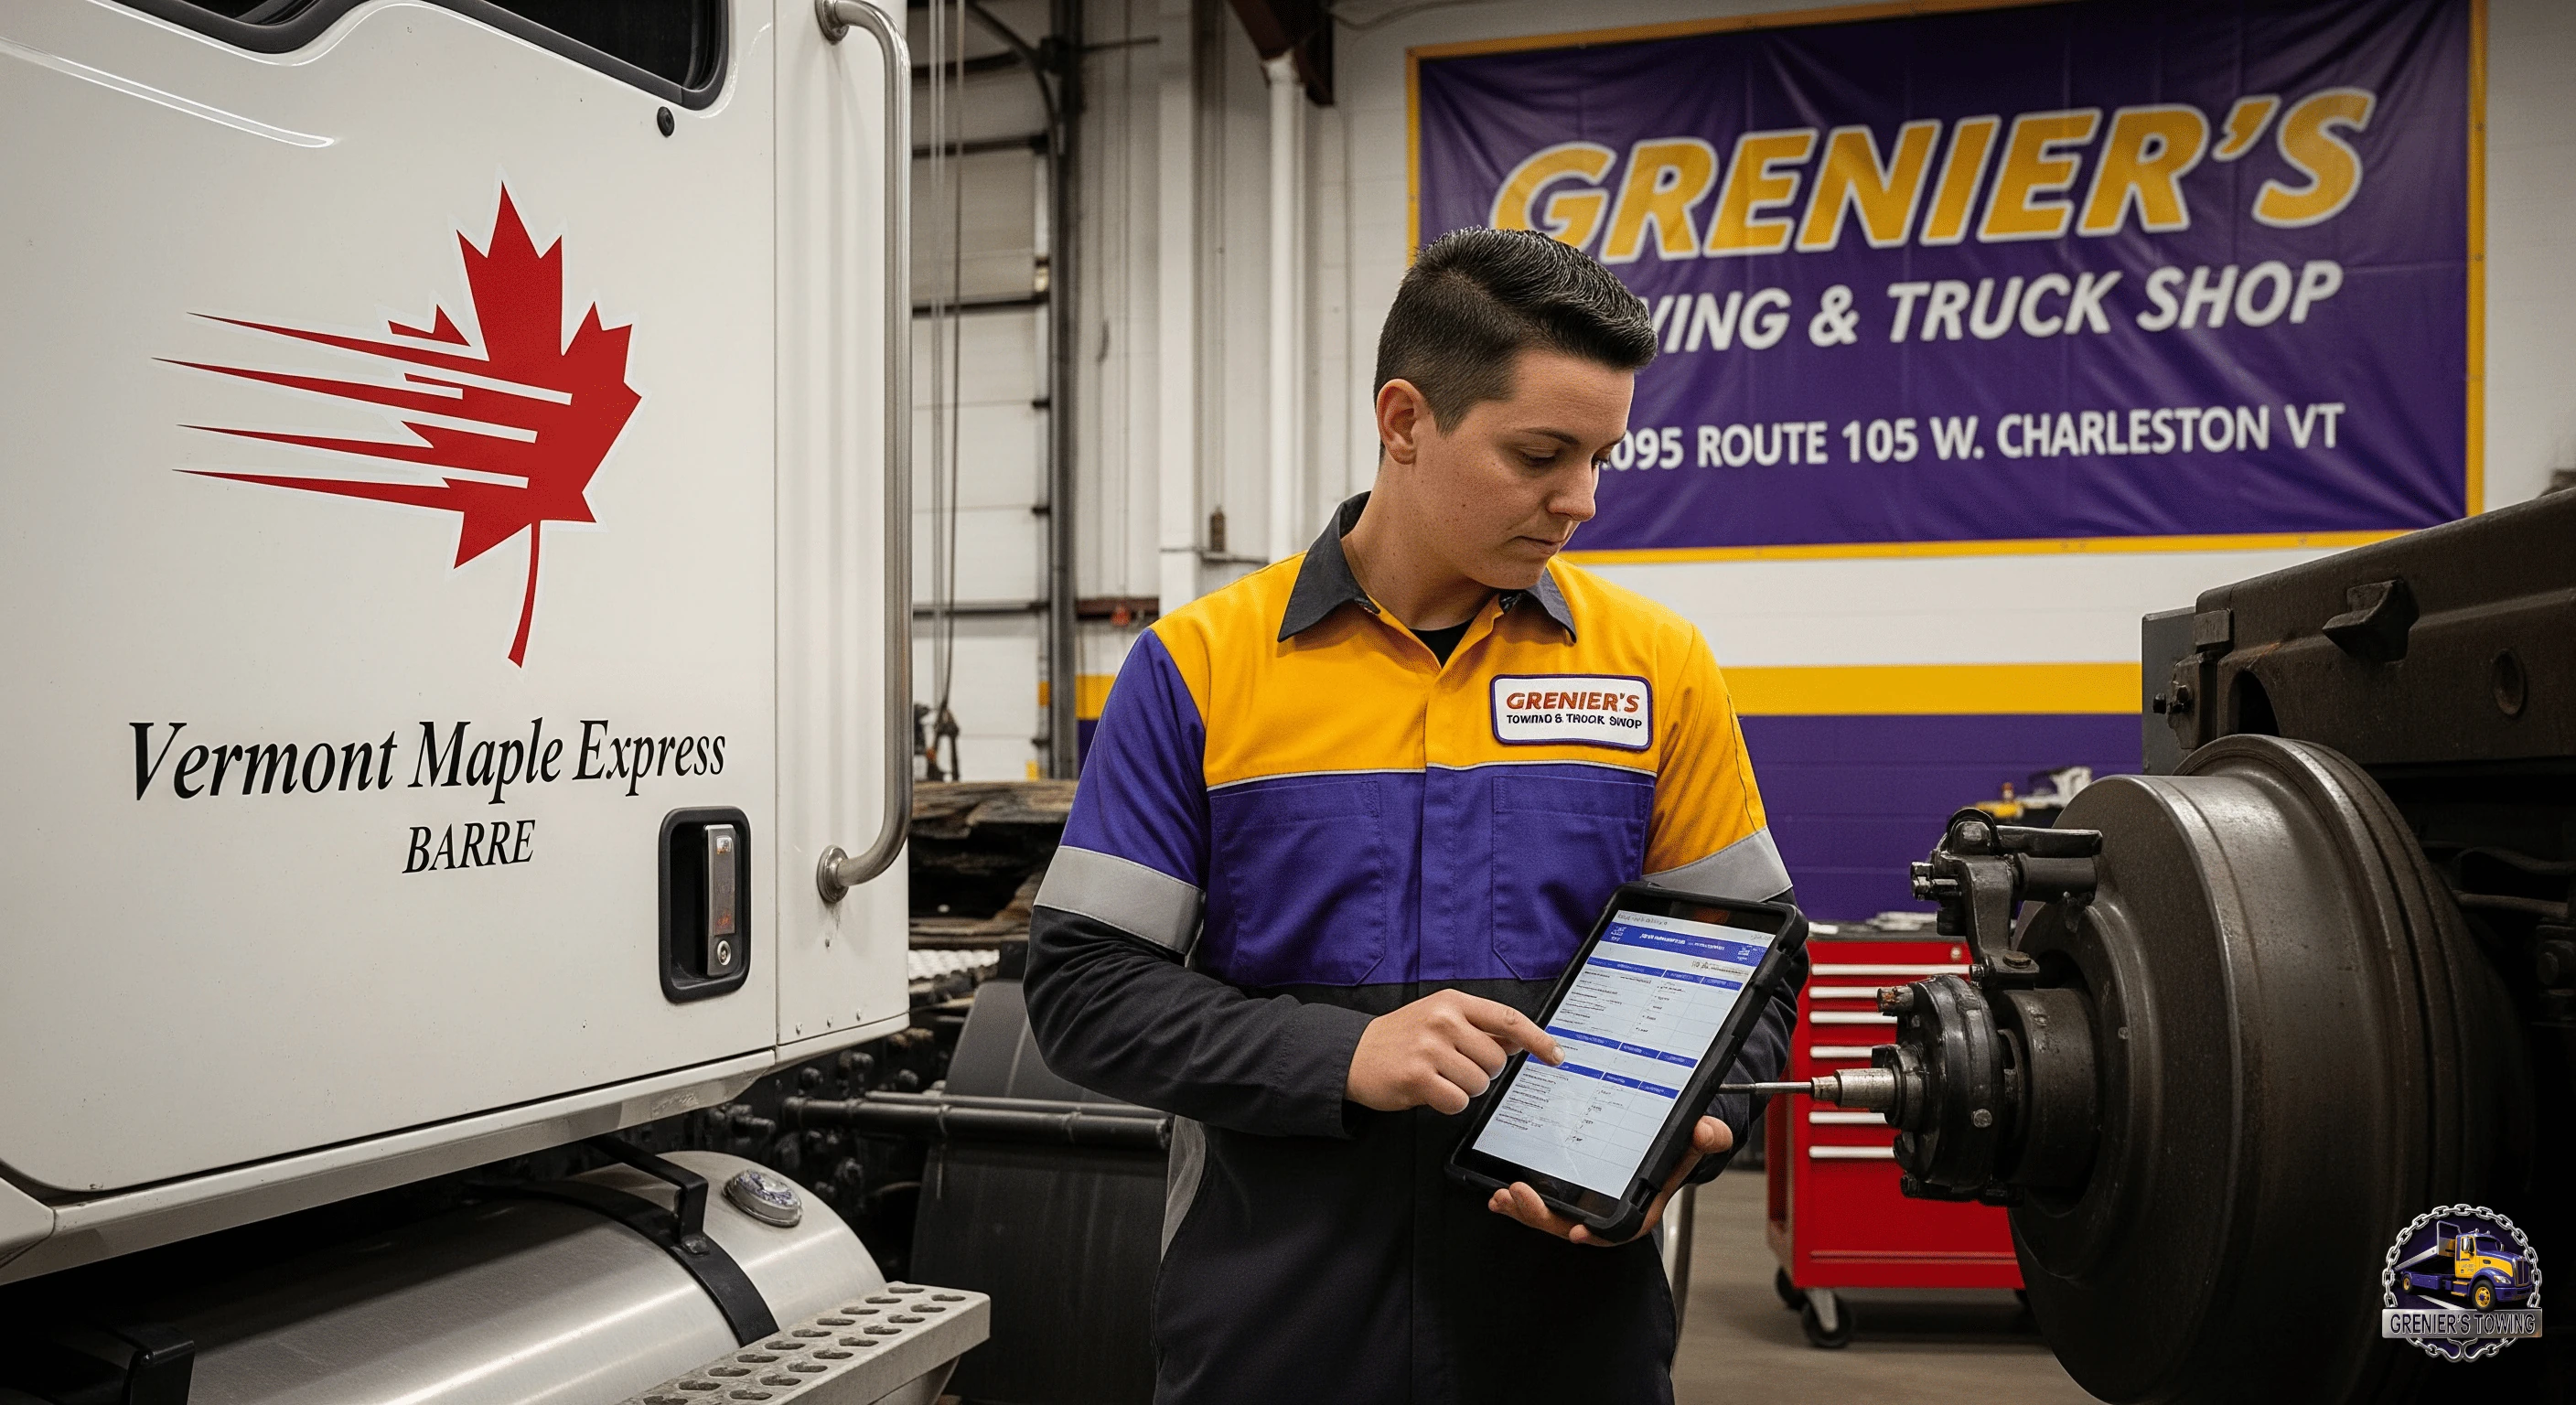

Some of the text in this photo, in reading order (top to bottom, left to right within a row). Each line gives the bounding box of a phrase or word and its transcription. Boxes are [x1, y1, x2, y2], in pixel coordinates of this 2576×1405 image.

[1489, 87, 2374, 263] GRENIER'S
[1809, 285, 1860, 347] &
[1886, 272, 2121, 344] TRUCK
[2136, 260, 2344, 331] SHOP
[1602, 402, 2345, 470] 095 ROUTE 105 W. CHARLESTON VT
[1506, 692, 1640, 713] GRENIER'S
[128, 716, 726, 805] Vermont Maple Express
[402, 819, 536, 874] BARRE
